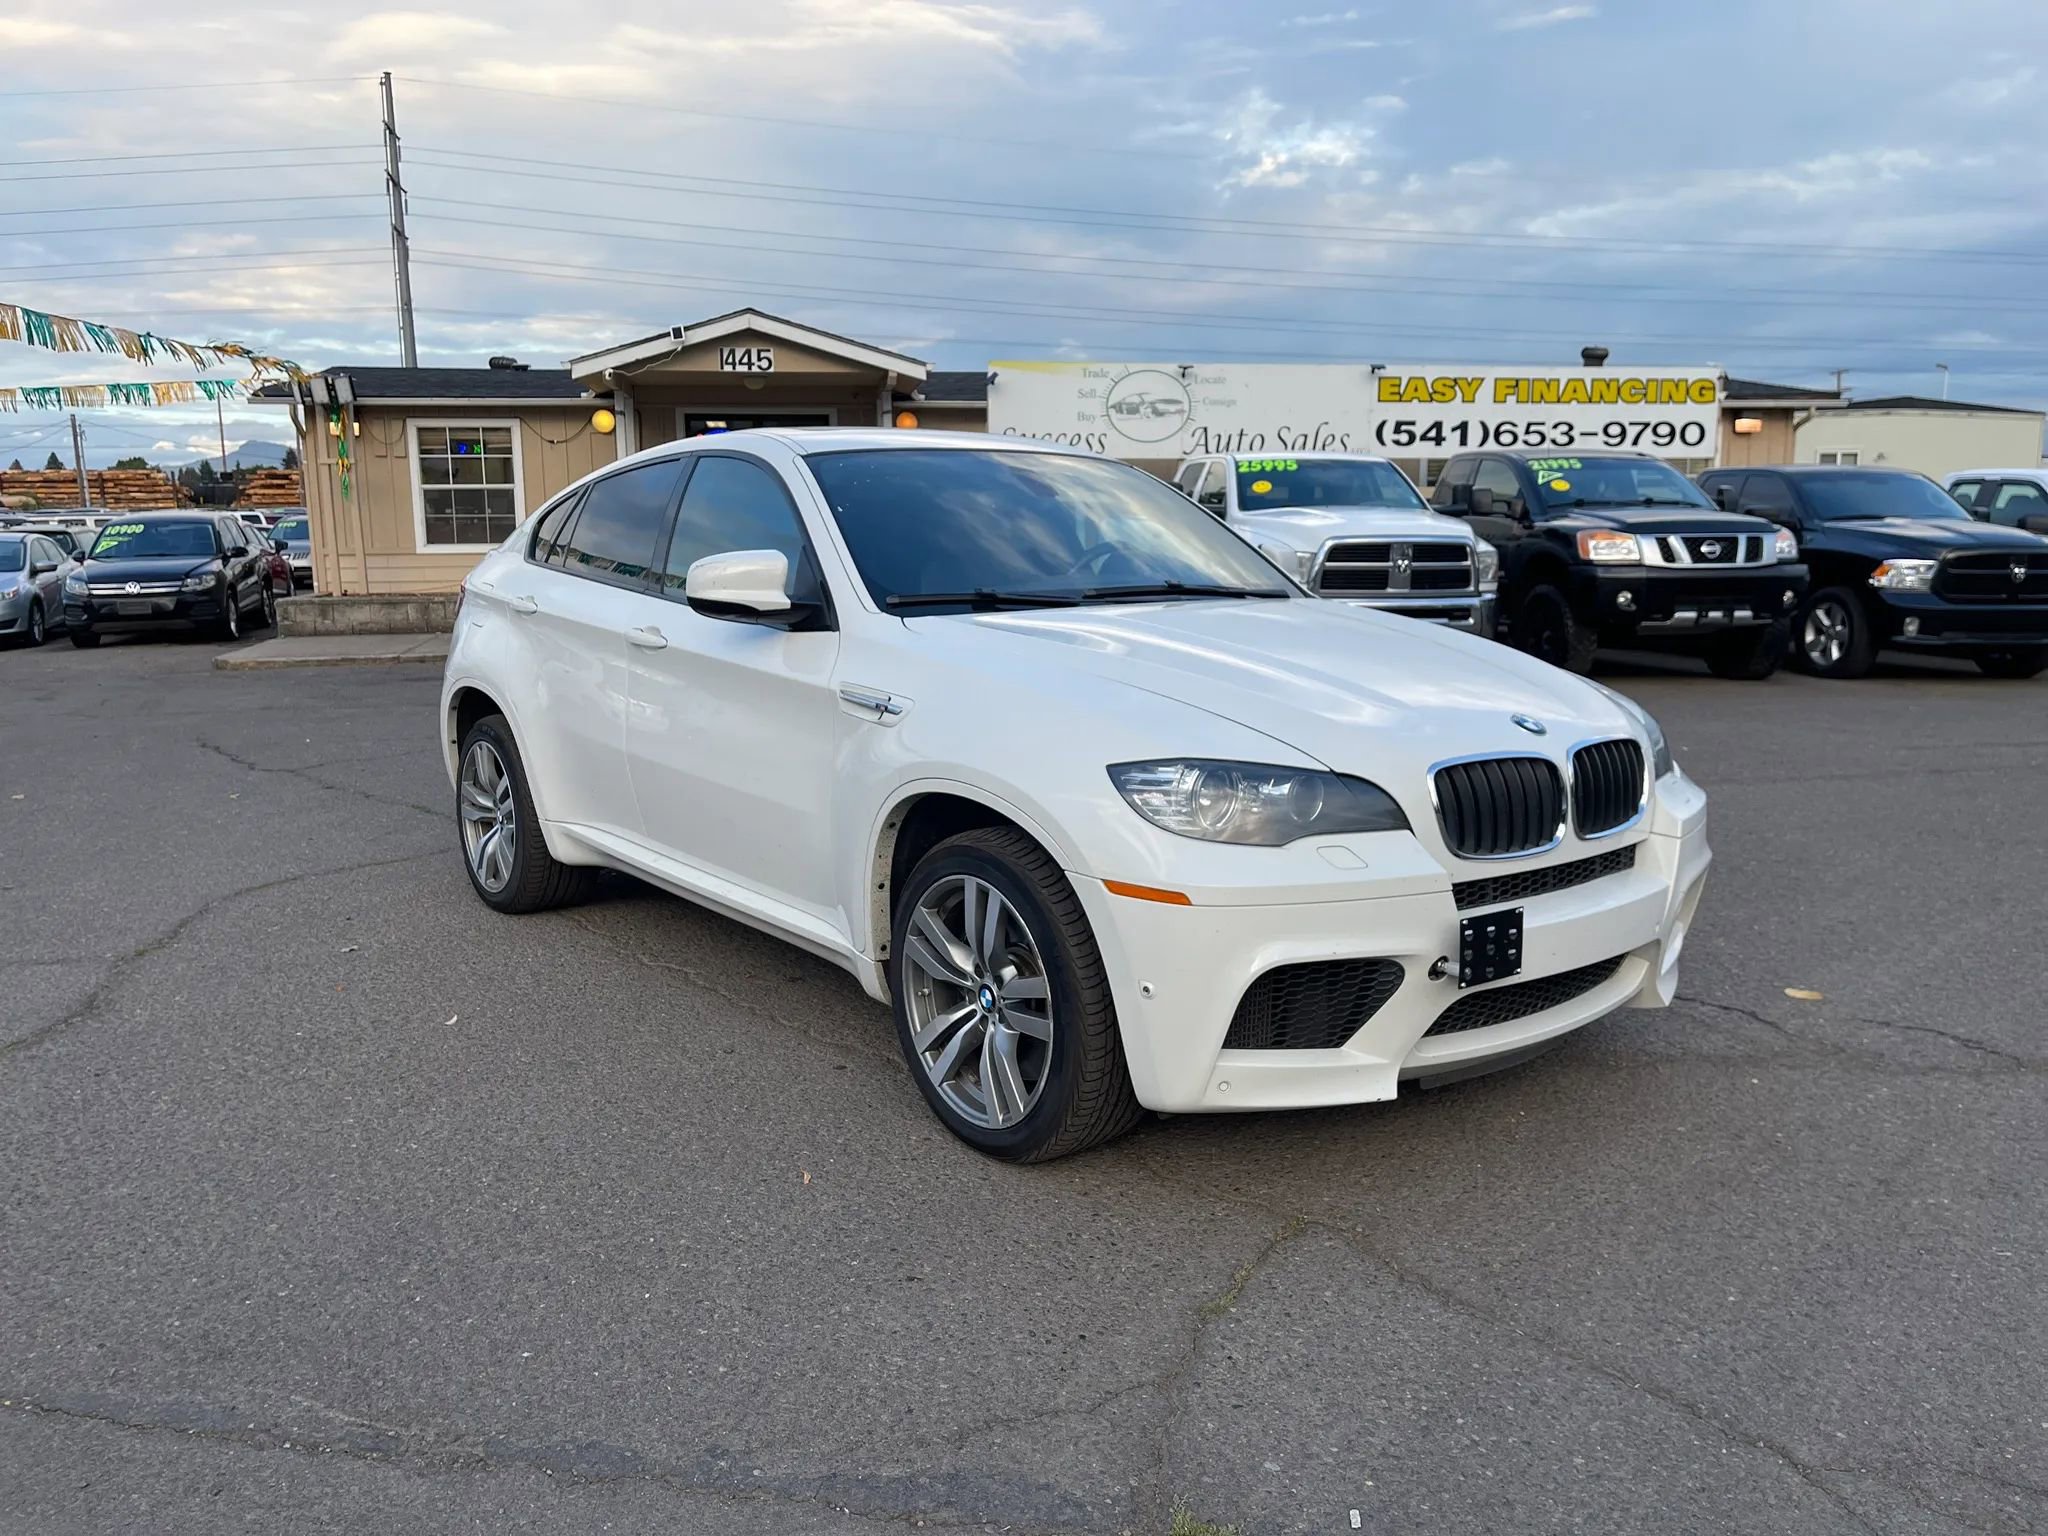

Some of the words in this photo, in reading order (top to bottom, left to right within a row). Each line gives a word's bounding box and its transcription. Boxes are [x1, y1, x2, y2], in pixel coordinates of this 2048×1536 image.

[719, 348, 773, 371] 1445
[1081, 368, 1110, 379] Trade
[1194, 374, 1227, 385] Locate
[1077, 388, 1097, 399] Sell
[1378, 376, 1485, 403] EASY
[1493, 377, 1716, 404] FINANCING
[1077, 412, 1097, 424] Buy
[1002, 426, 1107, 454] cess
[1182, 426, 1265, 455] Auto
[1277, 421, 1350, 452] Sales
[1375, 419, 1705, 447] (541)653-9790
[1238, 459, 1298, 473] 25995
[1527, 458, 1582, 471] 21995
[105, 524, 145, 536] 10900
